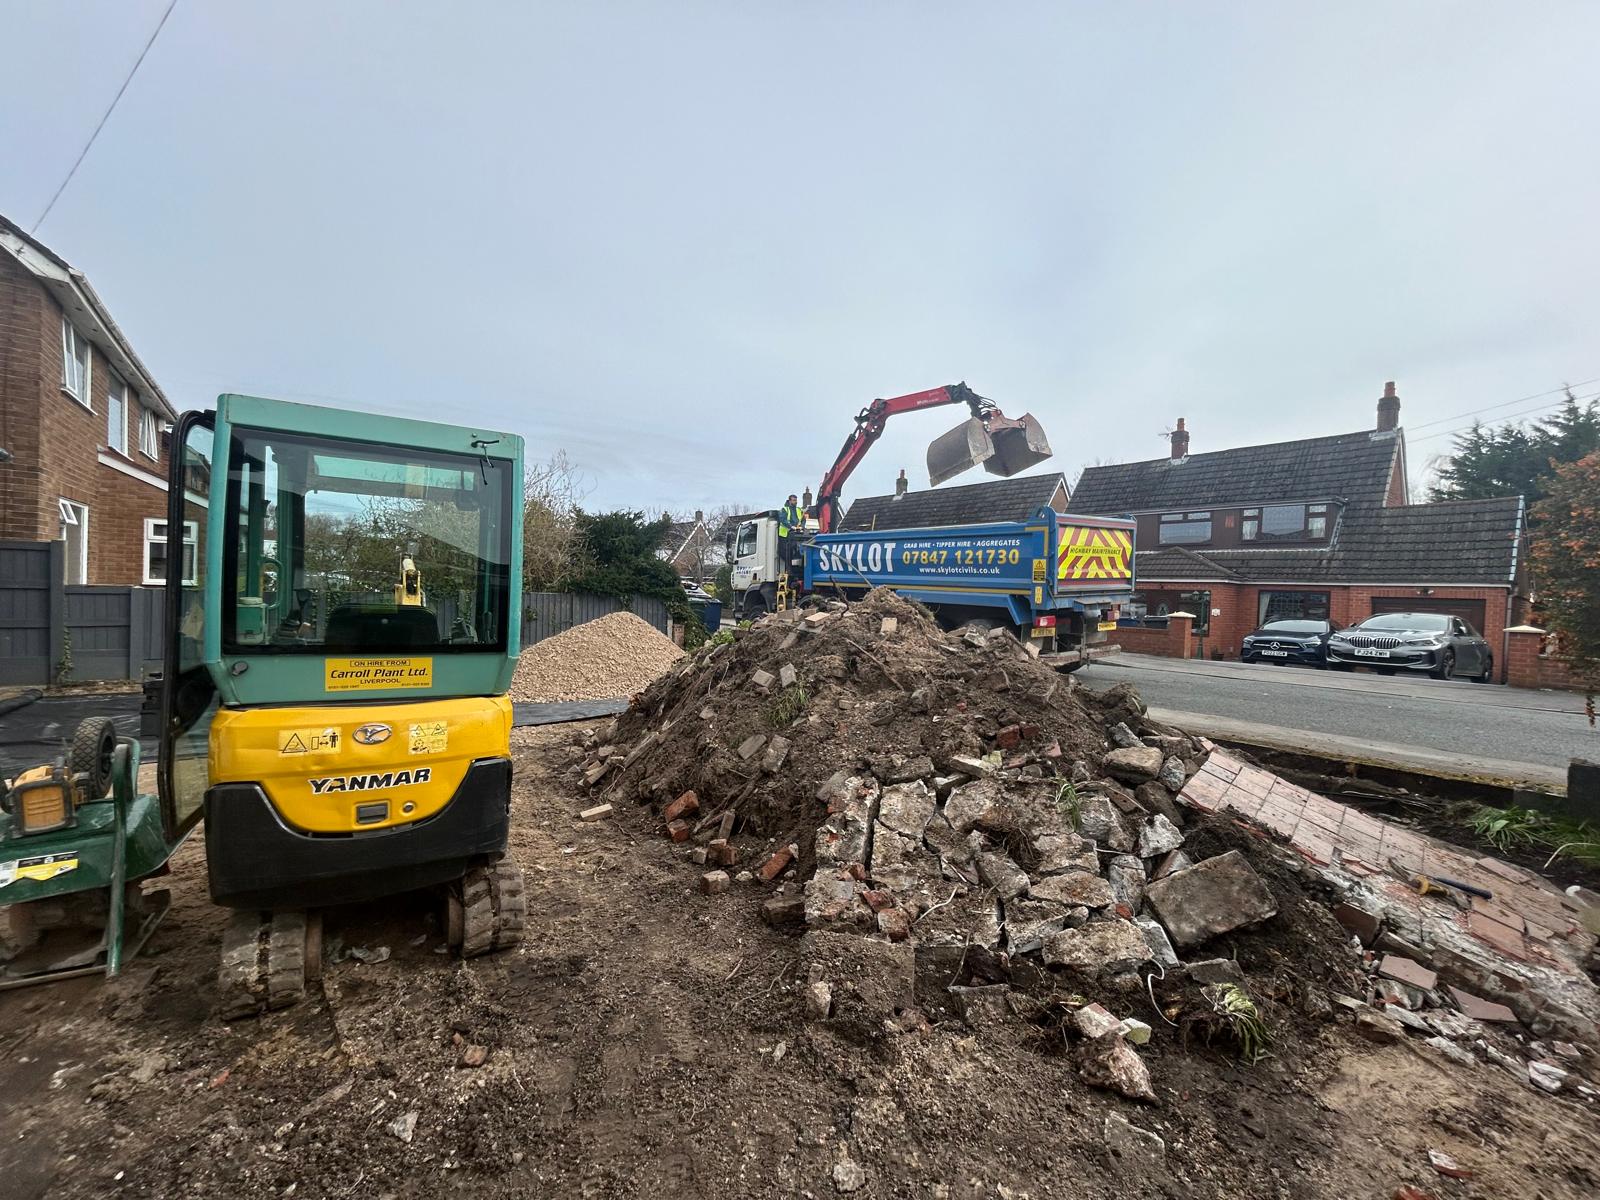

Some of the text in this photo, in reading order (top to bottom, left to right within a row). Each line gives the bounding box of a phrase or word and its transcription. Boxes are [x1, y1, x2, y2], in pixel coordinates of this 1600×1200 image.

[976, 539, 1020, 547] AGGREGATES
[819, 543, 896, 572] SKYLOT
[902, 548, 1020, 565] 07847 121730
[919, 566, 1000, 575] www.skylotcivils.co.uk
[330, 667, 428, 679] Carroll Plant Ltd.
[309, 768, 431, 793] YANMAR
